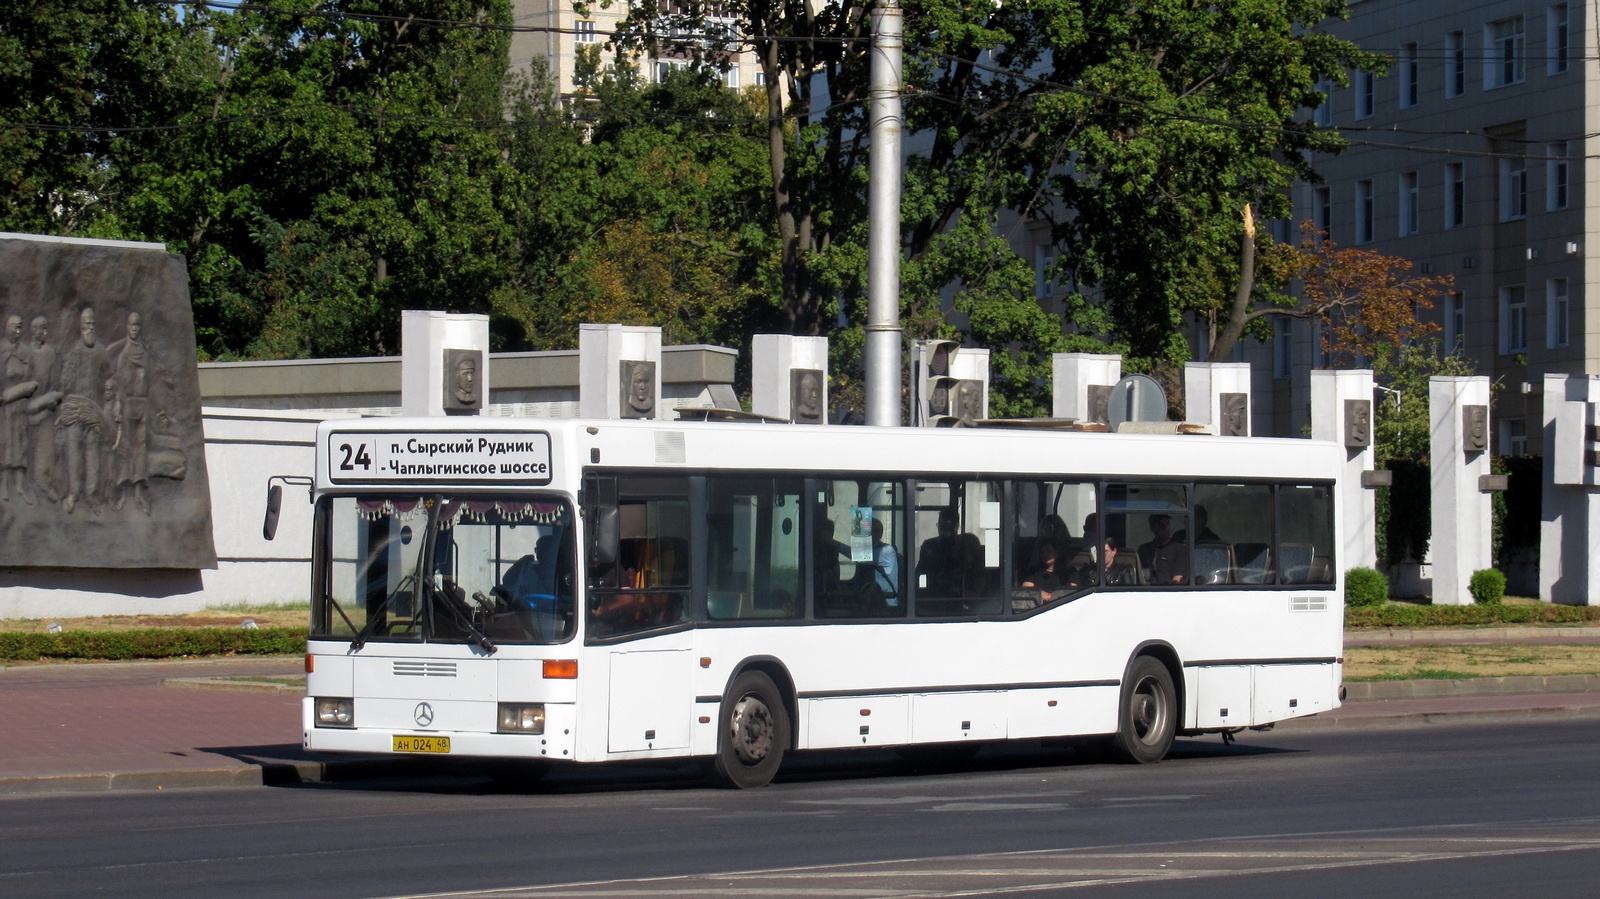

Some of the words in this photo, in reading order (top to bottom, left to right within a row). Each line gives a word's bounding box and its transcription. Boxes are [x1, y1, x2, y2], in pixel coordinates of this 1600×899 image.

[391, 442, 404, 454] п.
[407, 438, 474, 457] Сырский
[478, 438, 534, 456] Рудник
[339, 443, 372, 471] 24
[389, 459, 496, 475] Чаплыгинское
[500, 462, 547, 474] шоссе
[413, 739, 432, 750] 024
[436, 739, 447, 748] 48
